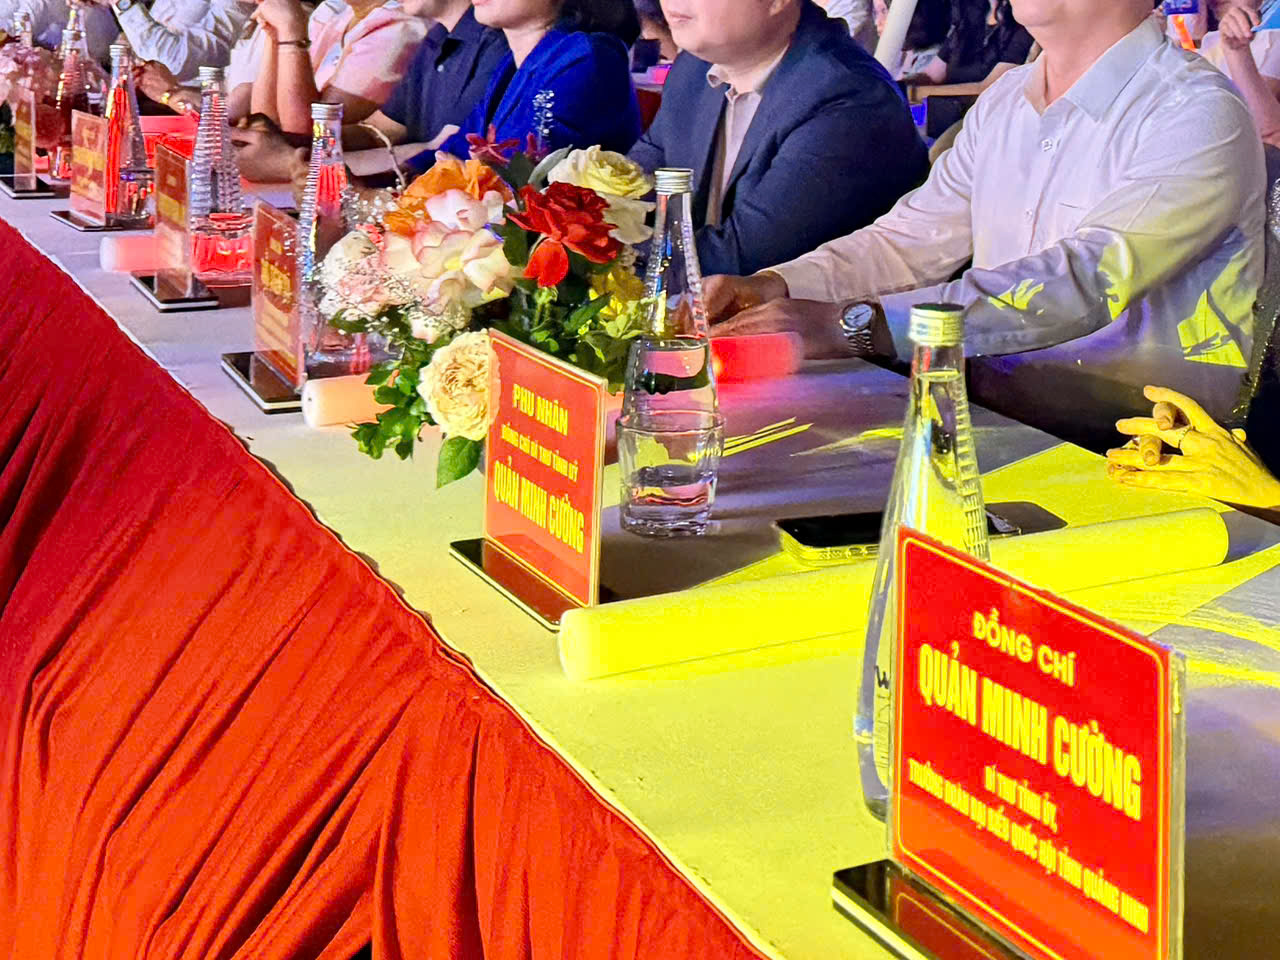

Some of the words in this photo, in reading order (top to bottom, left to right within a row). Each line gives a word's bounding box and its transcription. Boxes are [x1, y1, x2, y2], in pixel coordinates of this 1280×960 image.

[512, 383, 534, 417] PHU
[536, 395, 568, 436] NHÂN
[494, 455, 519, 511] QUẢN
[521, 476, 547, 529] MINH
[549, 493, 584, 554] CƯỜNG
[973, 607, 1034, 663] ĐỒNG
[1037, 644, 1076, 687] CHÍ
[919, 641, 978, 727] QUẢN
[981, 676, 1048, 765] MINH
[1053, 715, 1142, 821] CƯỜNG
